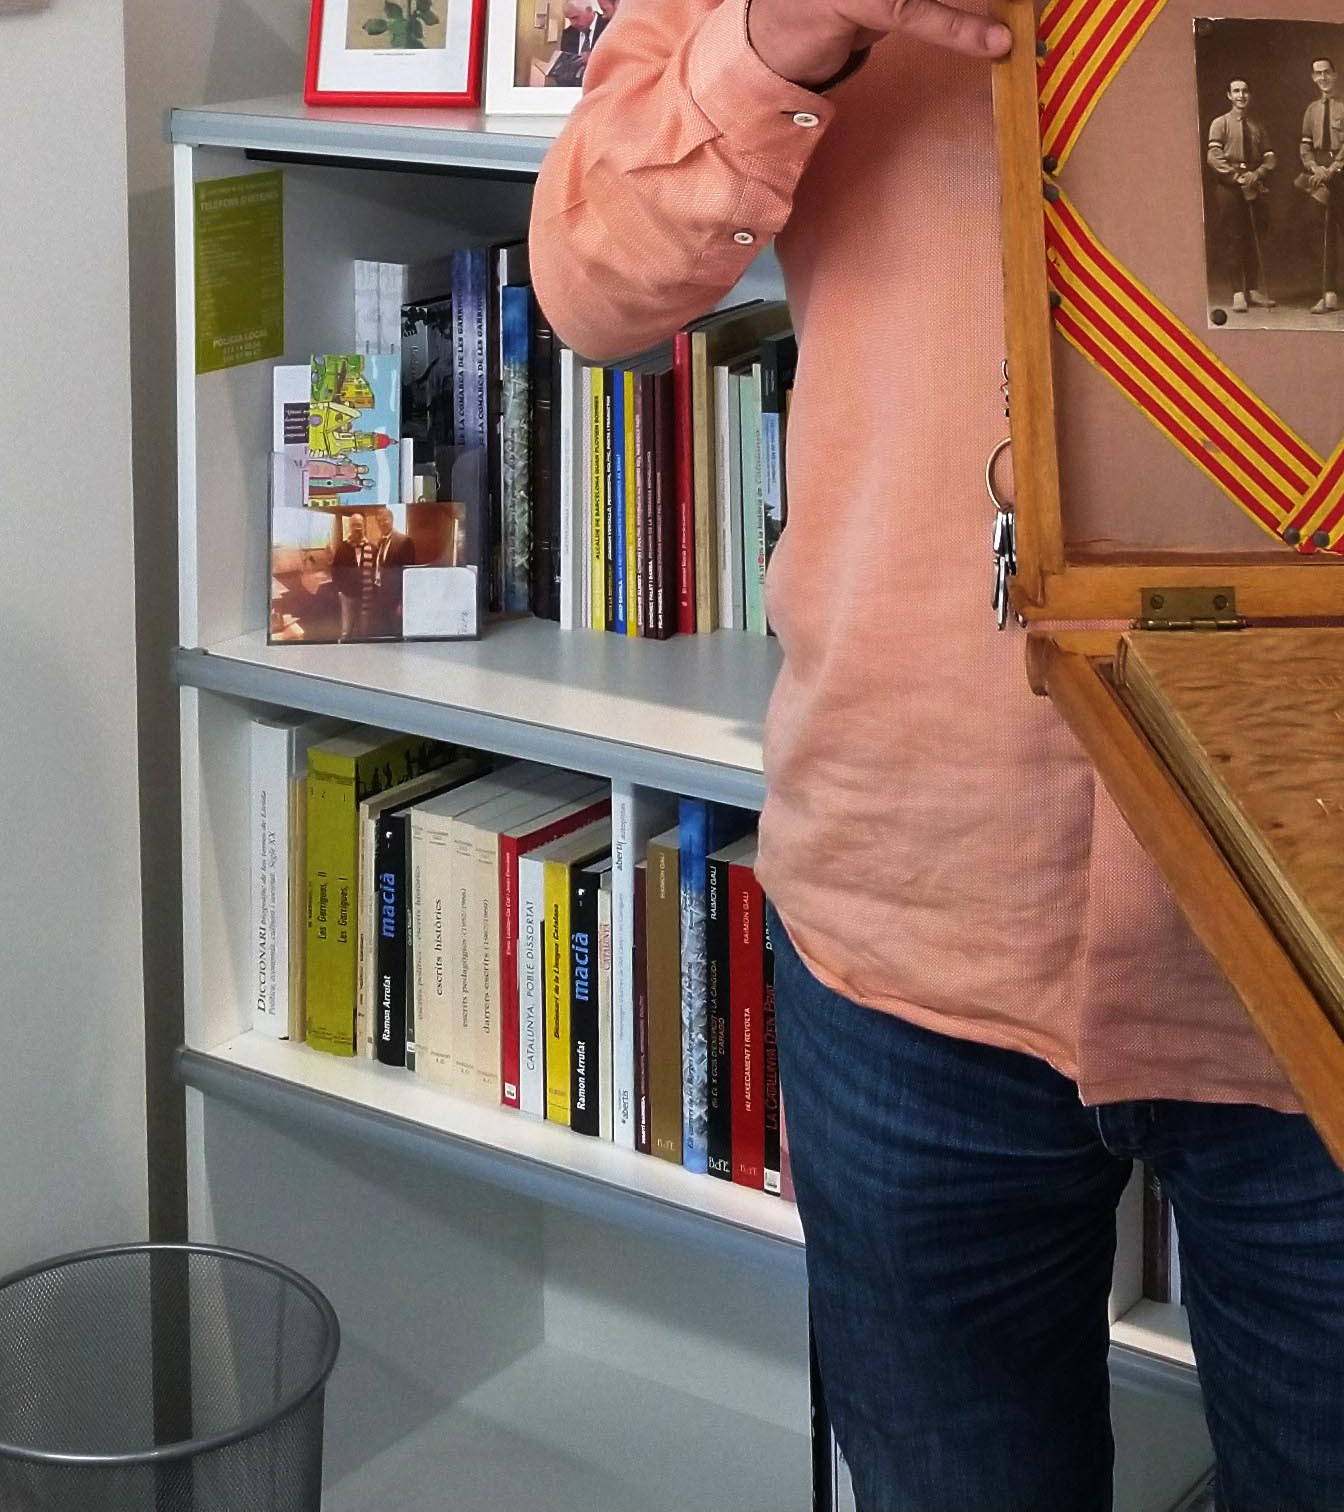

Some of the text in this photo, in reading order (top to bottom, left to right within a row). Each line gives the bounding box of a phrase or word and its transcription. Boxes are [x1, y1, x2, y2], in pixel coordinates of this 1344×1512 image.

[317, 883, 329, 923] Garrigues,
[338, 885, 350, 943] Les Garrigues,
[710, 887, 718, 920] RAIMON
[317, 926, 327, 940] Les
[433, 899, 443, 996] escrits històrics
[525, 900, 535, 960] DISSORTAT
[256, 926, 267, 1013] DICCIONARI
[379, 872, 396, 1041] Ramon Arrufat macià
[526, 965, 535, 998] POBLE
[482, 992, 491, 1034] darrers
[570, 932, 589, 1110] Ramon Arrufat macià
[619, 1090, 629, 1120] abertis
